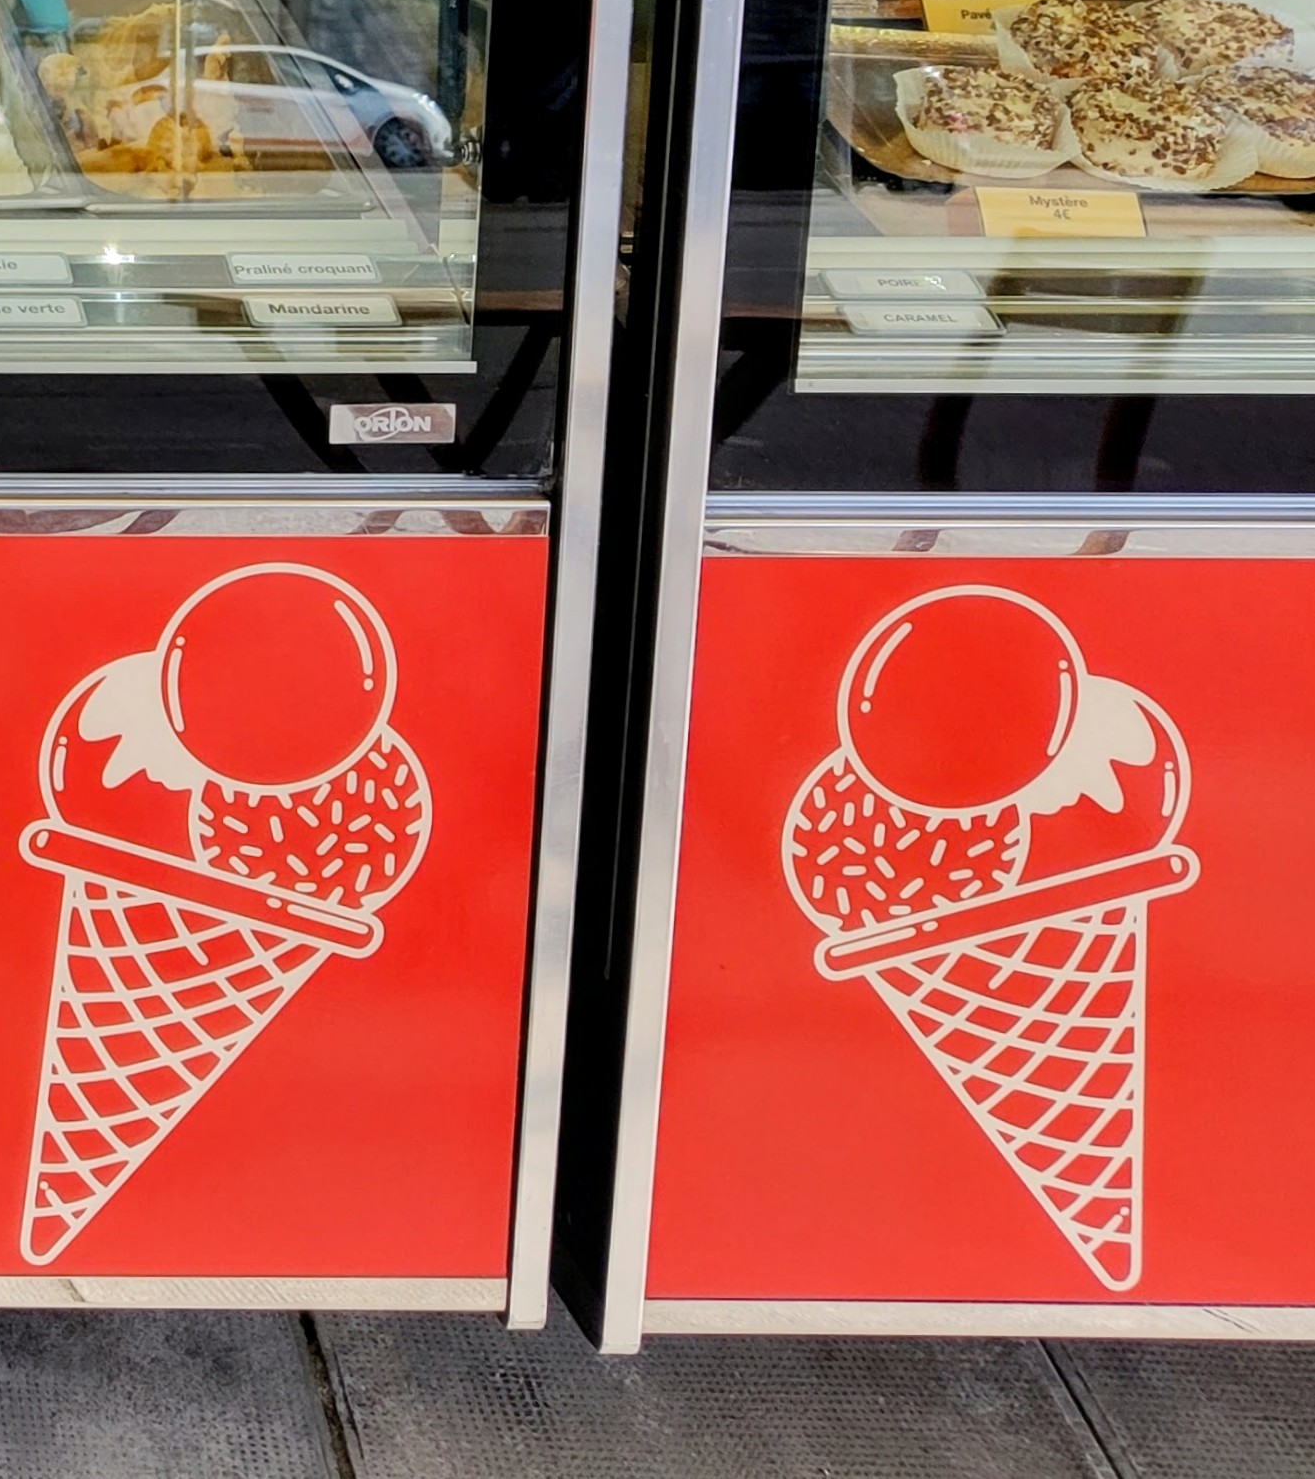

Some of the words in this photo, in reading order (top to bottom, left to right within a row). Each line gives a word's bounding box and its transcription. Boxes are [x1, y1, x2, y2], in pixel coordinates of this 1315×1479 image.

[960, 8, 992, 20] Pavé
[1029, 194, 1089, 209] Mystère
[1053, 209, 1072, 220] 4€
[234, 262, 293, 277] Praliné
[298, 262, 373, 279] croquant
[17, 303, 66, 317] verte
[268, 301, 370, 316] Mandarine
[883, 313, 957, 323] CARAMEL
[353, 407, 432, 440] ORION
